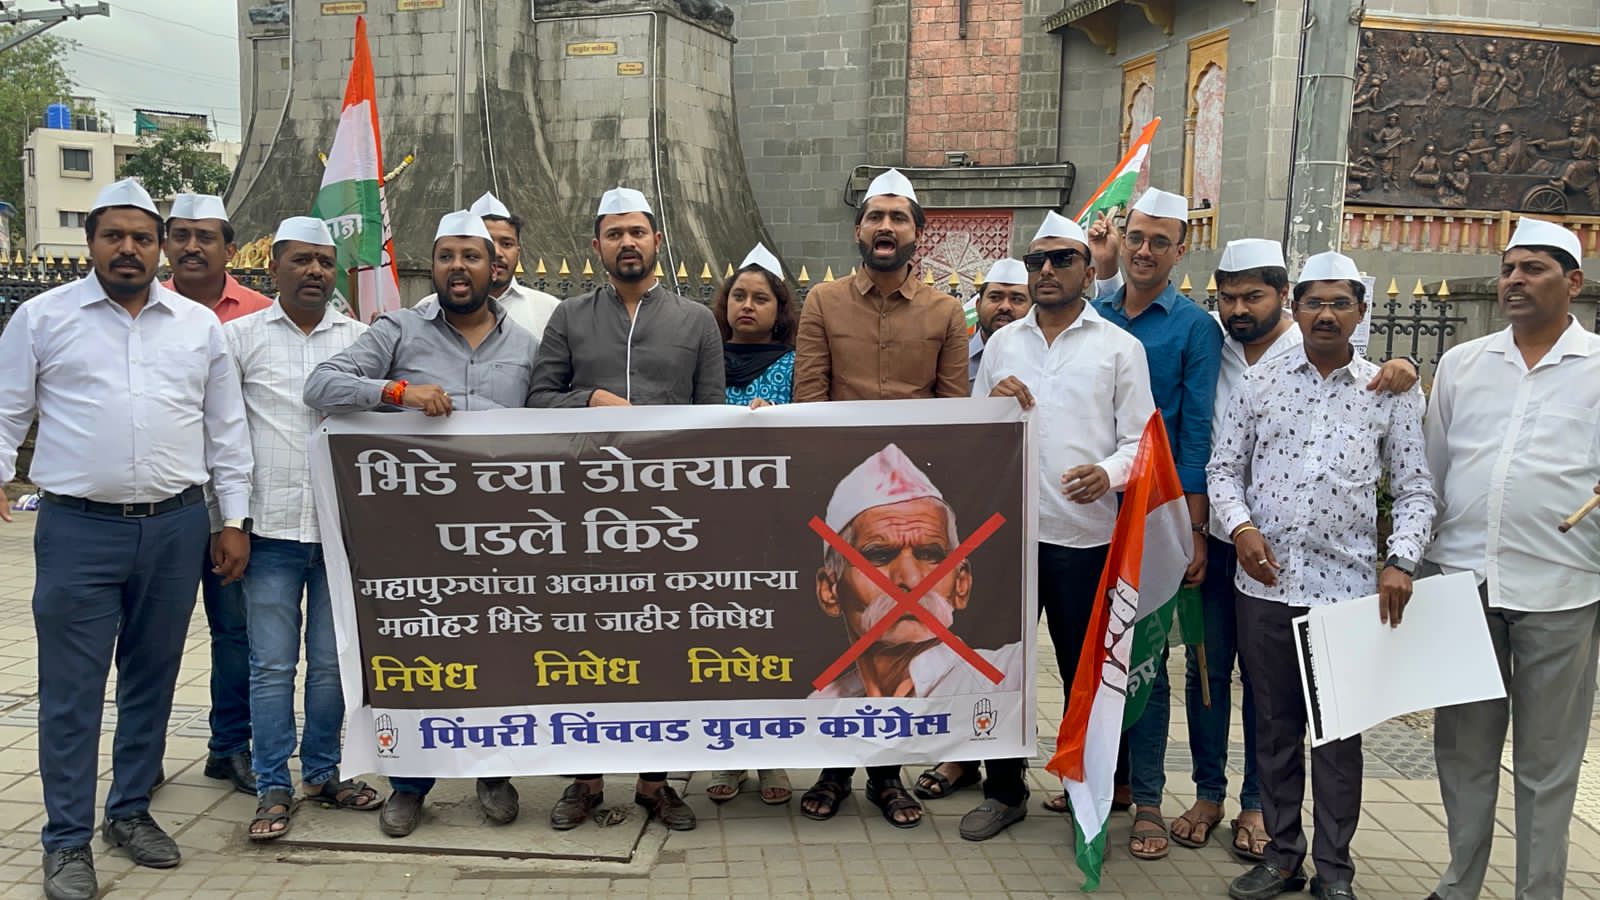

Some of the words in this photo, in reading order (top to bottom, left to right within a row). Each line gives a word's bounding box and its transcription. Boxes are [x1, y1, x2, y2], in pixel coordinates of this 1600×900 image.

[355, 448, 457, 496] भिडे
[471, 461, 566, 495] च्या
[579, 446, 792, 493] डोक्यात
[435, 509, 567, 556] पडले
[581, 506, 700, 554] किडे
[359, 567, 537, 605] महापुरुषांचा
[545, 572, 656, 595] अवमान
[376, 609, 480, 639] मनोहर
[486, 606, 543, 634] भिडे
[551, 611, 587, 633] चा
[594, 603, 682, 633] जाहीर
[688, 602, 775, 631] निषेध
[371, 655, 479, 692] निषेध
[534, 650, 641, 687] निषेध
[687, 647, 794, 684] निषेध
[419, 713, 538, 750] पिंपरी
[549, 711, 691, 745] चिंचवड
[702, 716, 807, 751] युवक
[817, 704, 952, 740] काँग्रेस
